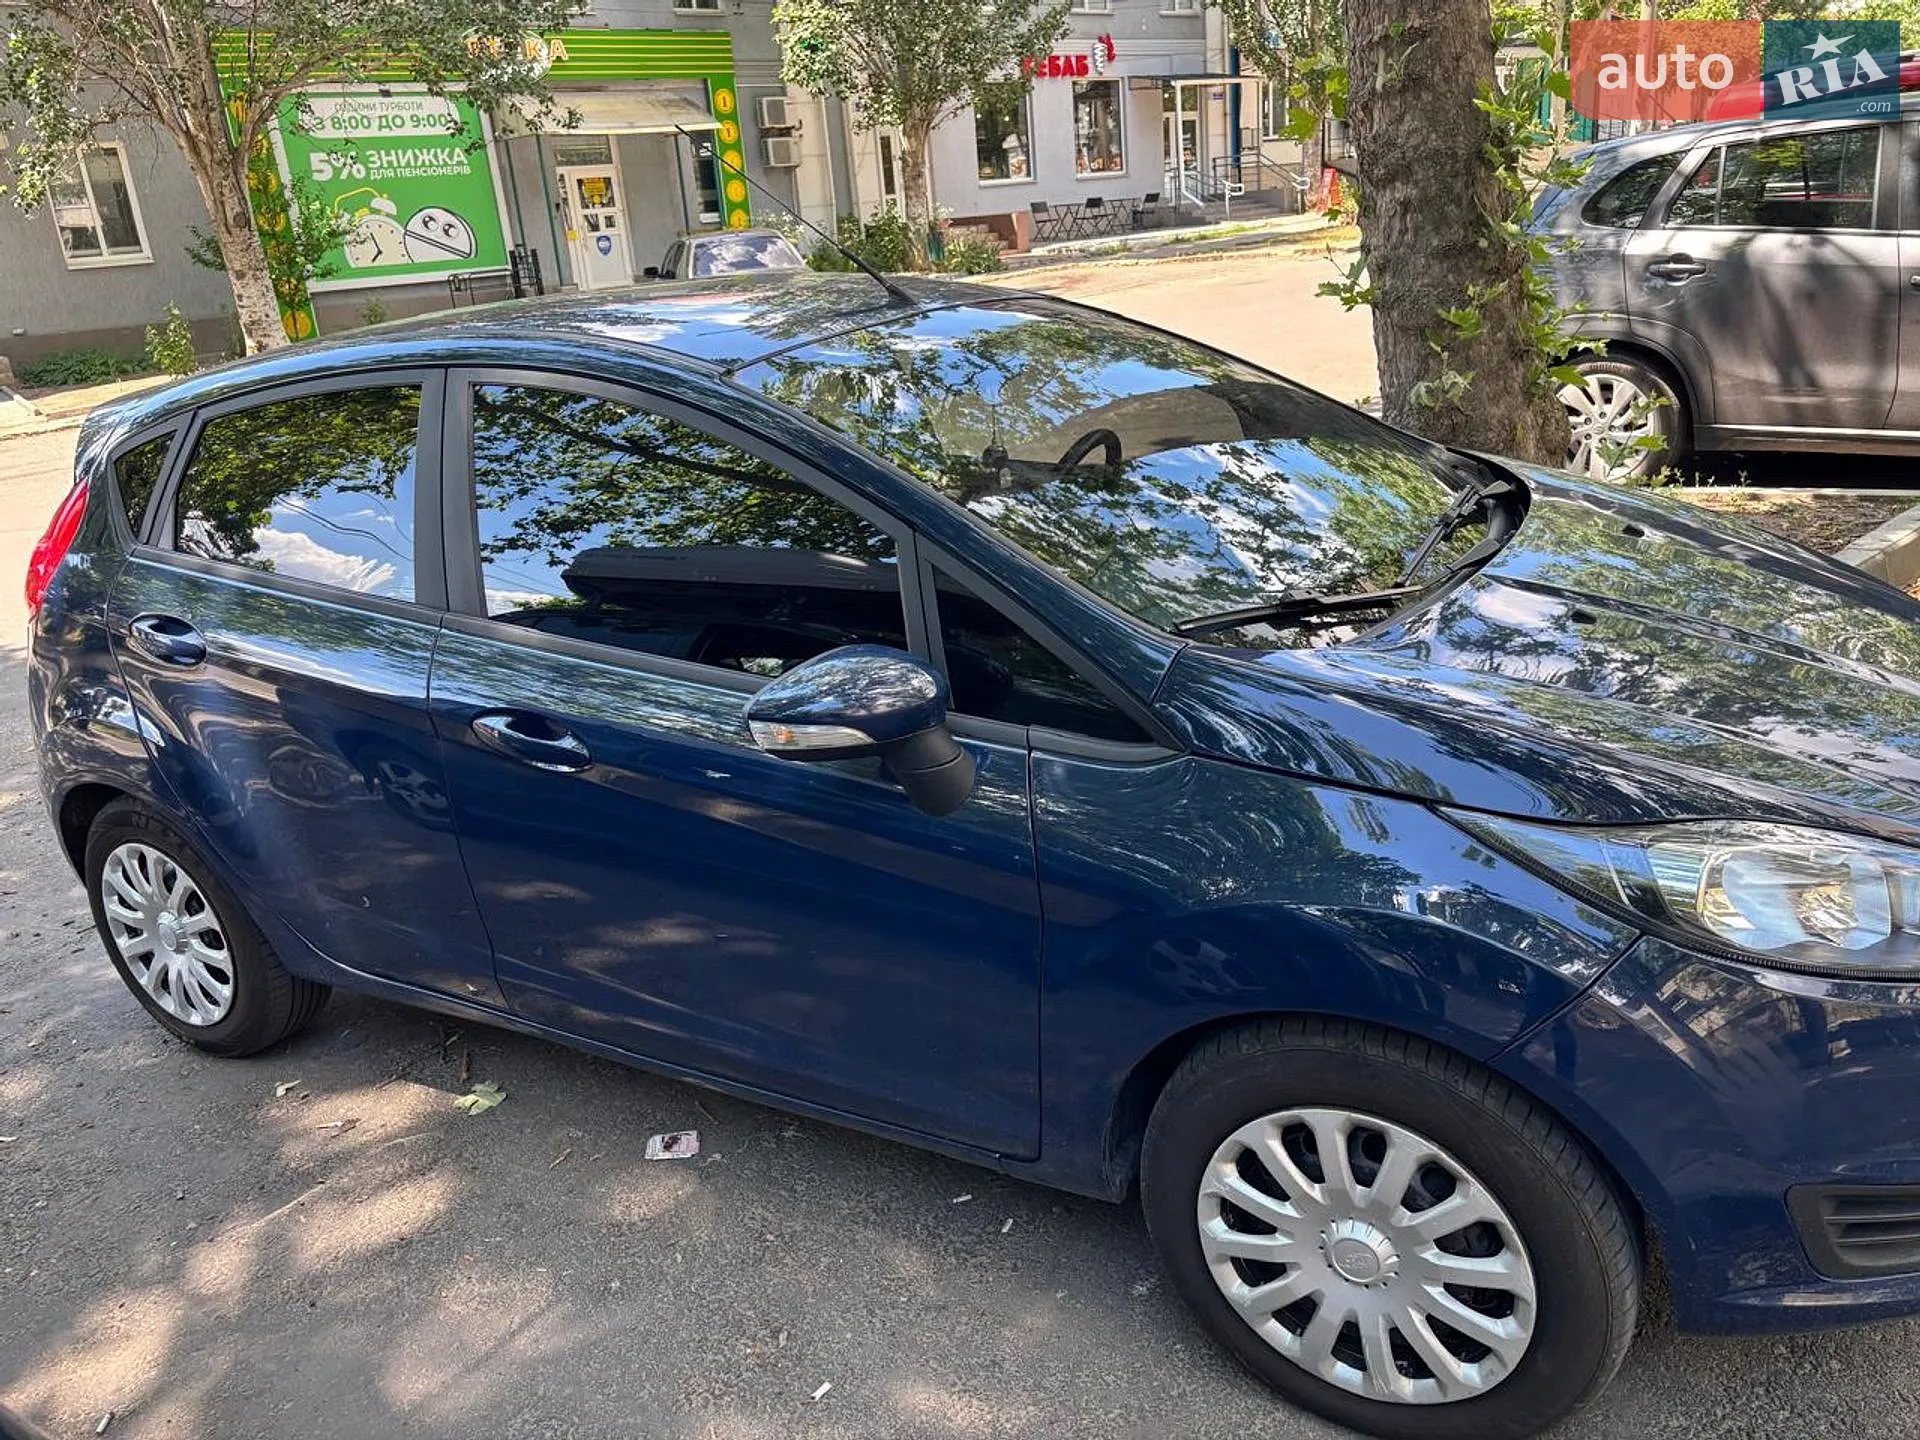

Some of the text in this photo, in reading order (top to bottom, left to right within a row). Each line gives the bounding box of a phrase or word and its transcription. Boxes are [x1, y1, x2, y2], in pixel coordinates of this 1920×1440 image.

[331, 115, 372, 130] 8:00
[378, 114, 405, 131] ДО
[410, 113, 448, 128] 9:00
[310, 148, 468, 181] 5% ЗНИЖКА
[370, 165, 471, 180] ДЛЯ ПЕНСІОНЕРІВ
